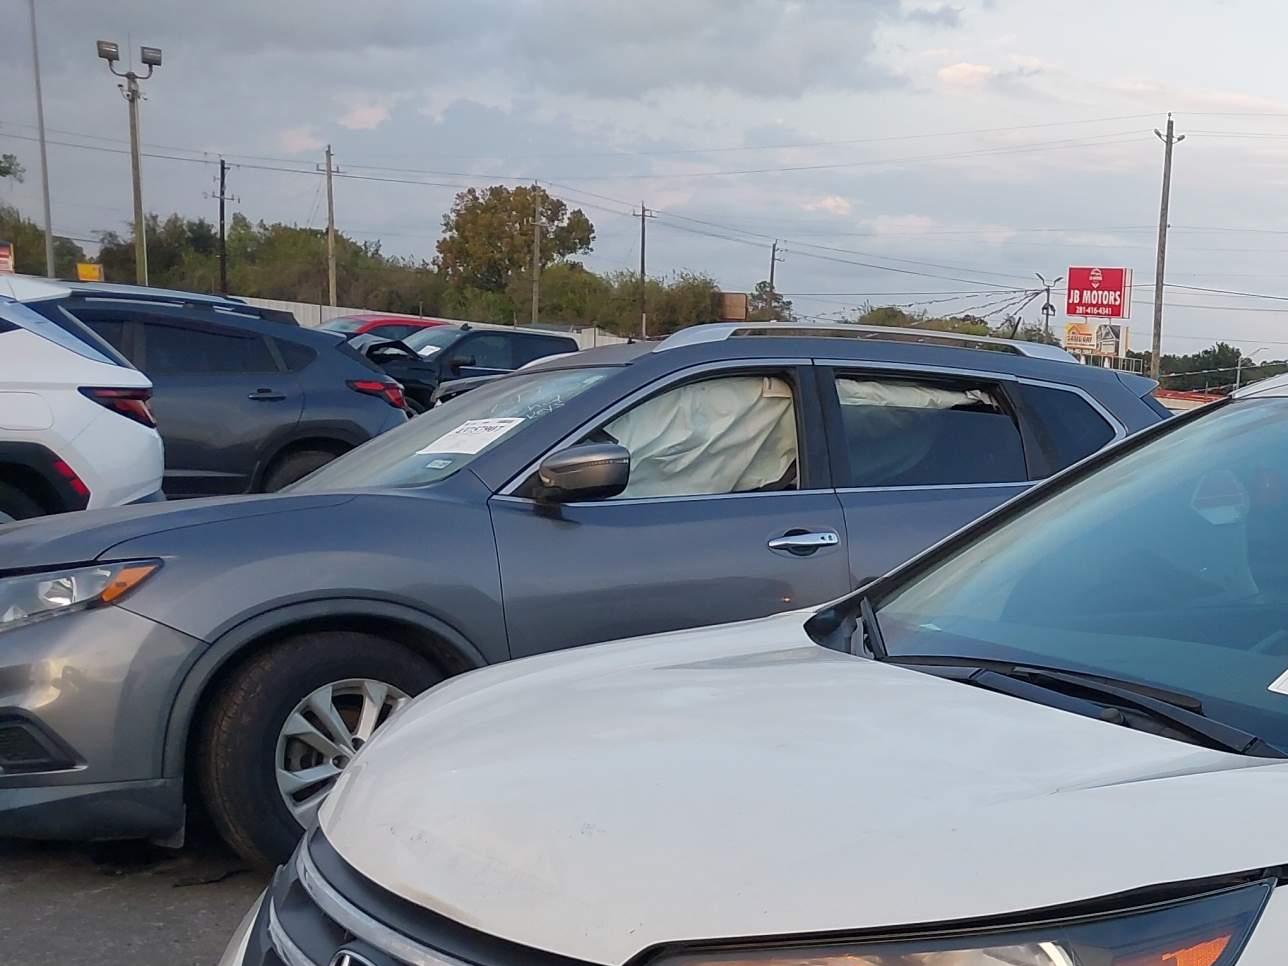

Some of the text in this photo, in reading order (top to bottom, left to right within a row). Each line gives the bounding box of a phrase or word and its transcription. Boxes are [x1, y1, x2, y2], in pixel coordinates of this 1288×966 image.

[1069, 290, 1121, 305] JB MOTORS
[1075, 306, 1112, 315] 281-416-4341
